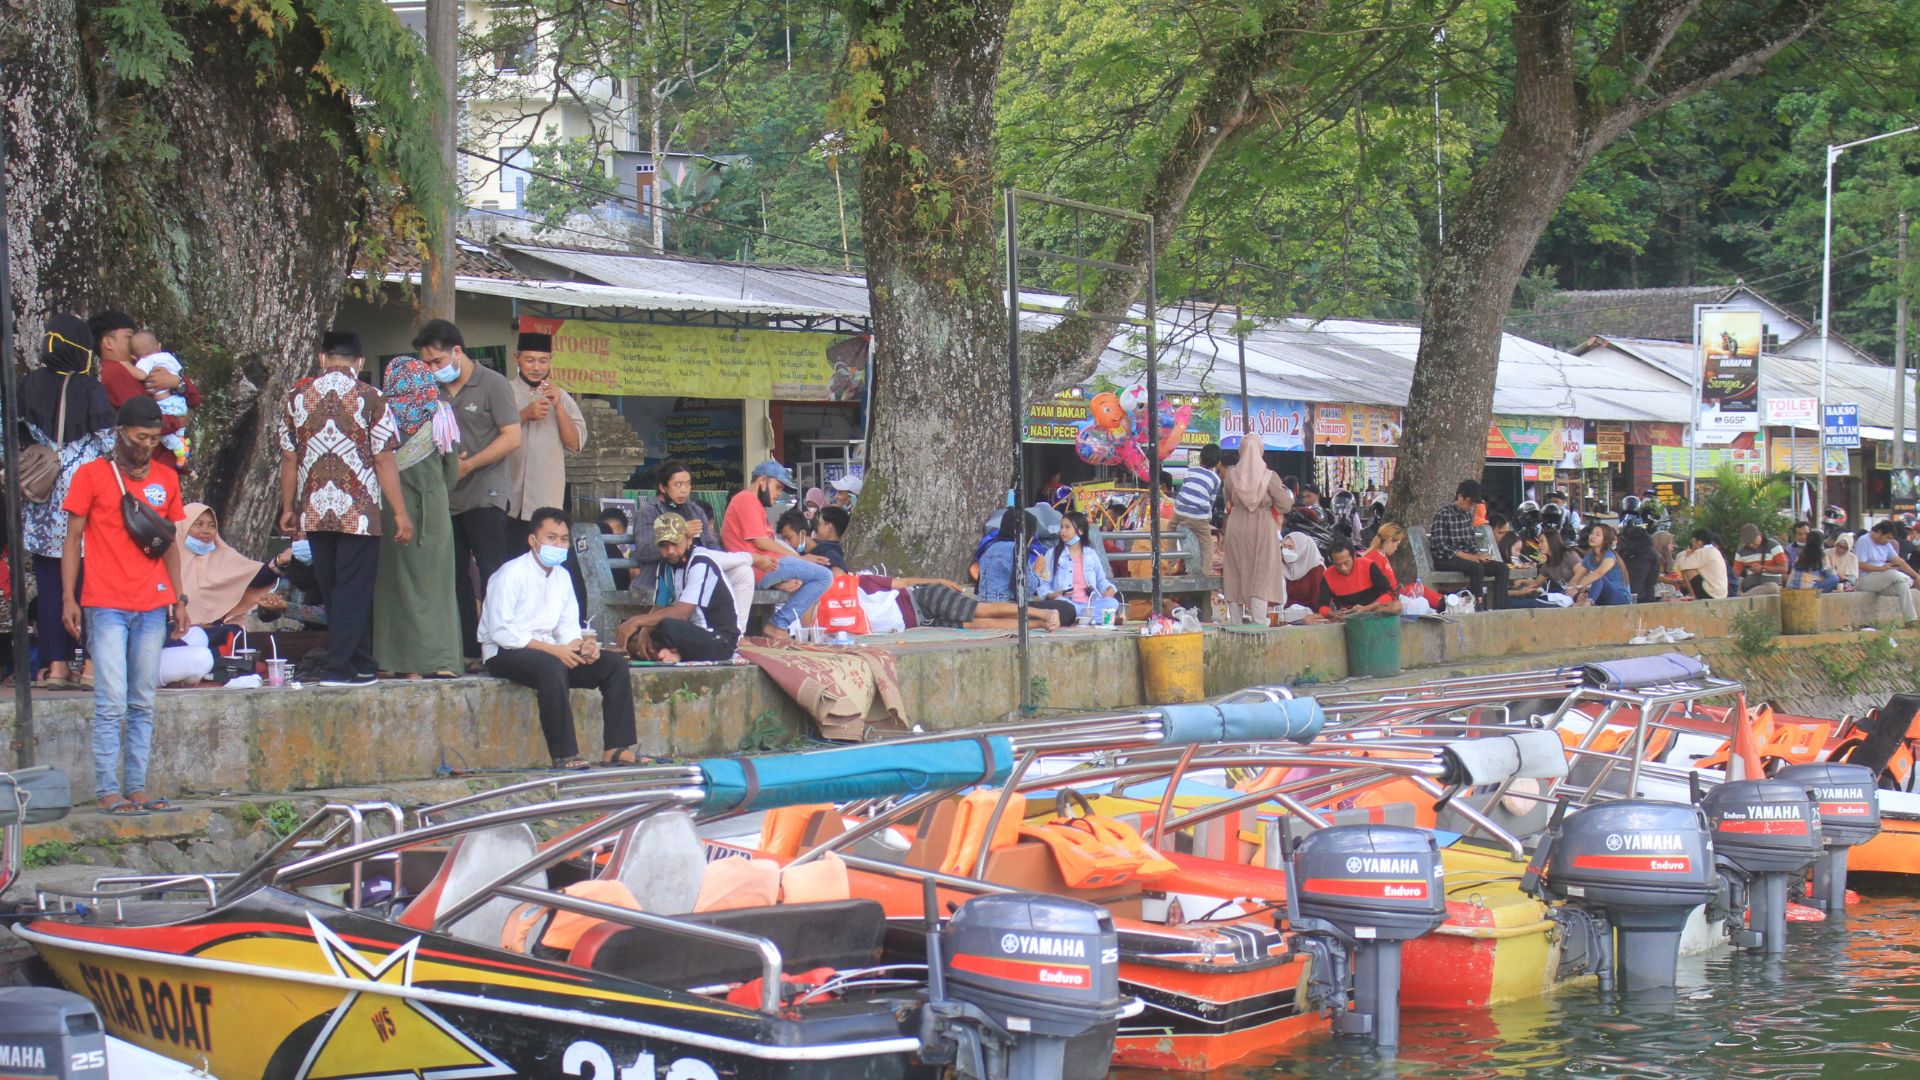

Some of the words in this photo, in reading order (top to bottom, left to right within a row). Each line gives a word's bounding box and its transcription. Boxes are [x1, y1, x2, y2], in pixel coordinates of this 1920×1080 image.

[552, 335, 610, 362] aroeng
[1719, 359, 1753, 368] HARAPAN
[548, 367, 617, 389] ampoeng
[1707, 377, 1746, 394] Surya
[1030, 405, 1055, 418] AYAM
[1056, 406, 1086, 419] BAKAR
[1767, 400, 1816, 411] TOILET
[1825, 406, 1856, 416] BAKSO
[1222, 408, 1256, 432] Bria
[1258, 408, 1290, 436] Salon
[1290, 411, 1301, 436] 2
[1837, 416, 1844, 425] &
[1030, 425, 1051, 437] NASI
[1825, 426, 1838, 435] MIE
[1838, 426, 1858, 435] AYAM
[1826, 436, 1858, 446] AREMA
[1822, 788, 1863, 799] YAMAHA
[1723, 811, 1746, 819] Enduro
[1747, 805, 1801, 819] YAMAHA
[1837, 806, 1865, 814] Enduro
[1624, 834, 1682, 850] YAMAHA
[1362, 857, 1419, 874] YAMAHA
[1650, 860, 1685, 870] Enduro
[1384, 885, 1422, 897] Enduro
[1019, 936, 1085, 957] YAMAHA
[1101, 947, 1118, 964] 25
[1039, 969, 1083, 985] Enduro
[78, 961, 146, 1035] STAR
[138, 976, 214, 1053] BOAT
[0, 1045, 46, 1069] MAHA
[71, 1050, 105, 1071] 25
